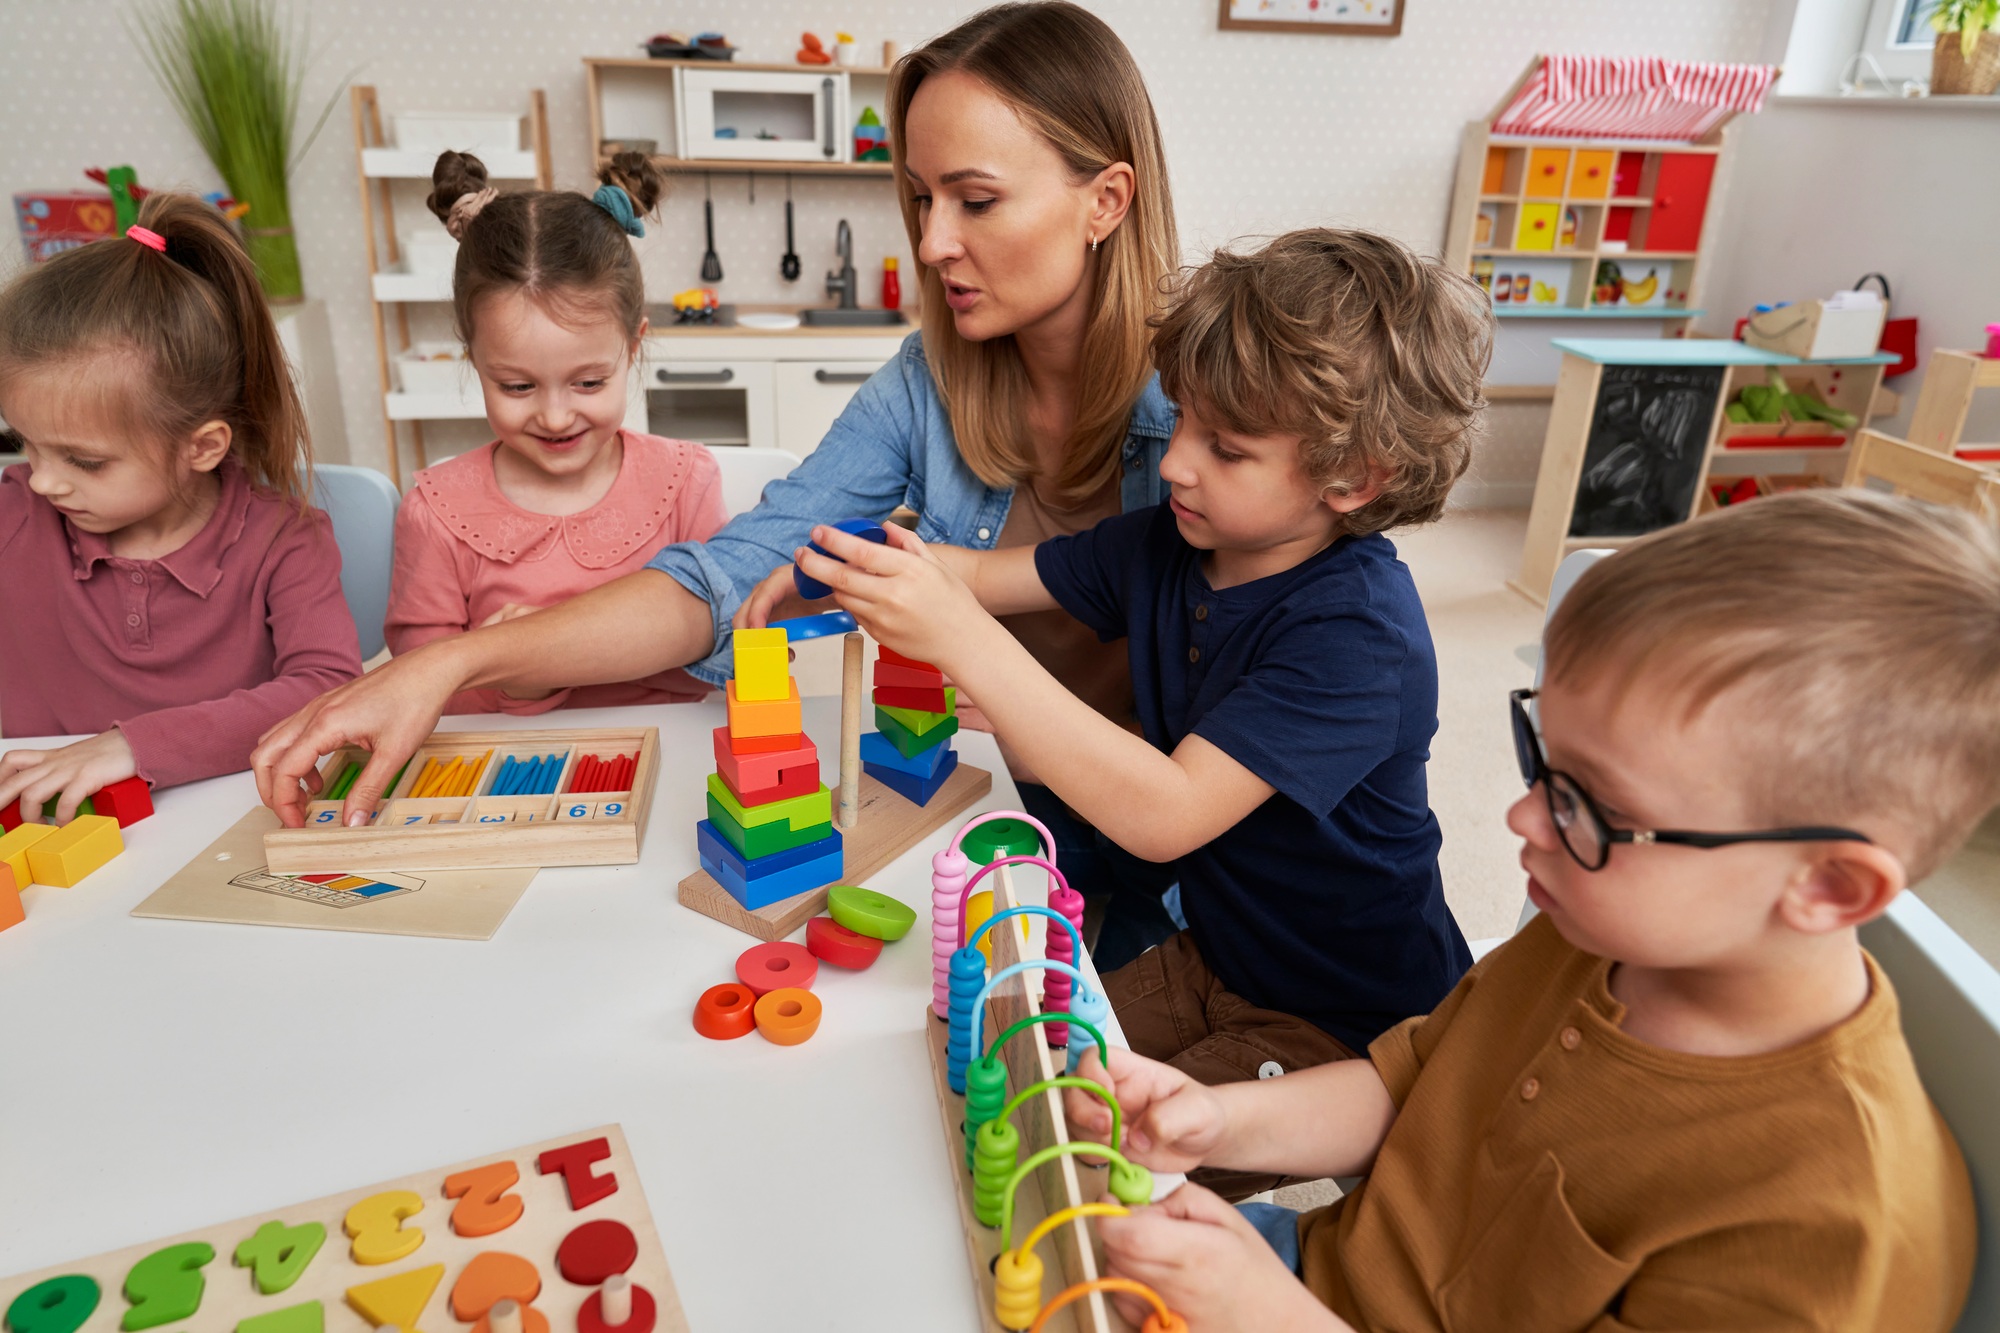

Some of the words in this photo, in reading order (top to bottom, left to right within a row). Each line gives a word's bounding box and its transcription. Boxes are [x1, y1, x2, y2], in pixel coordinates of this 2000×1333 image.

[315, 810, 337, 823] 5
[443, 1160, 524, 1238] 2
[537, 1136, 619, 1211] 1
[235, 1219, 327, 1295] 4
[344, 1190, 425, 1266] 3
[122, 1241, 216, 1332] 5
